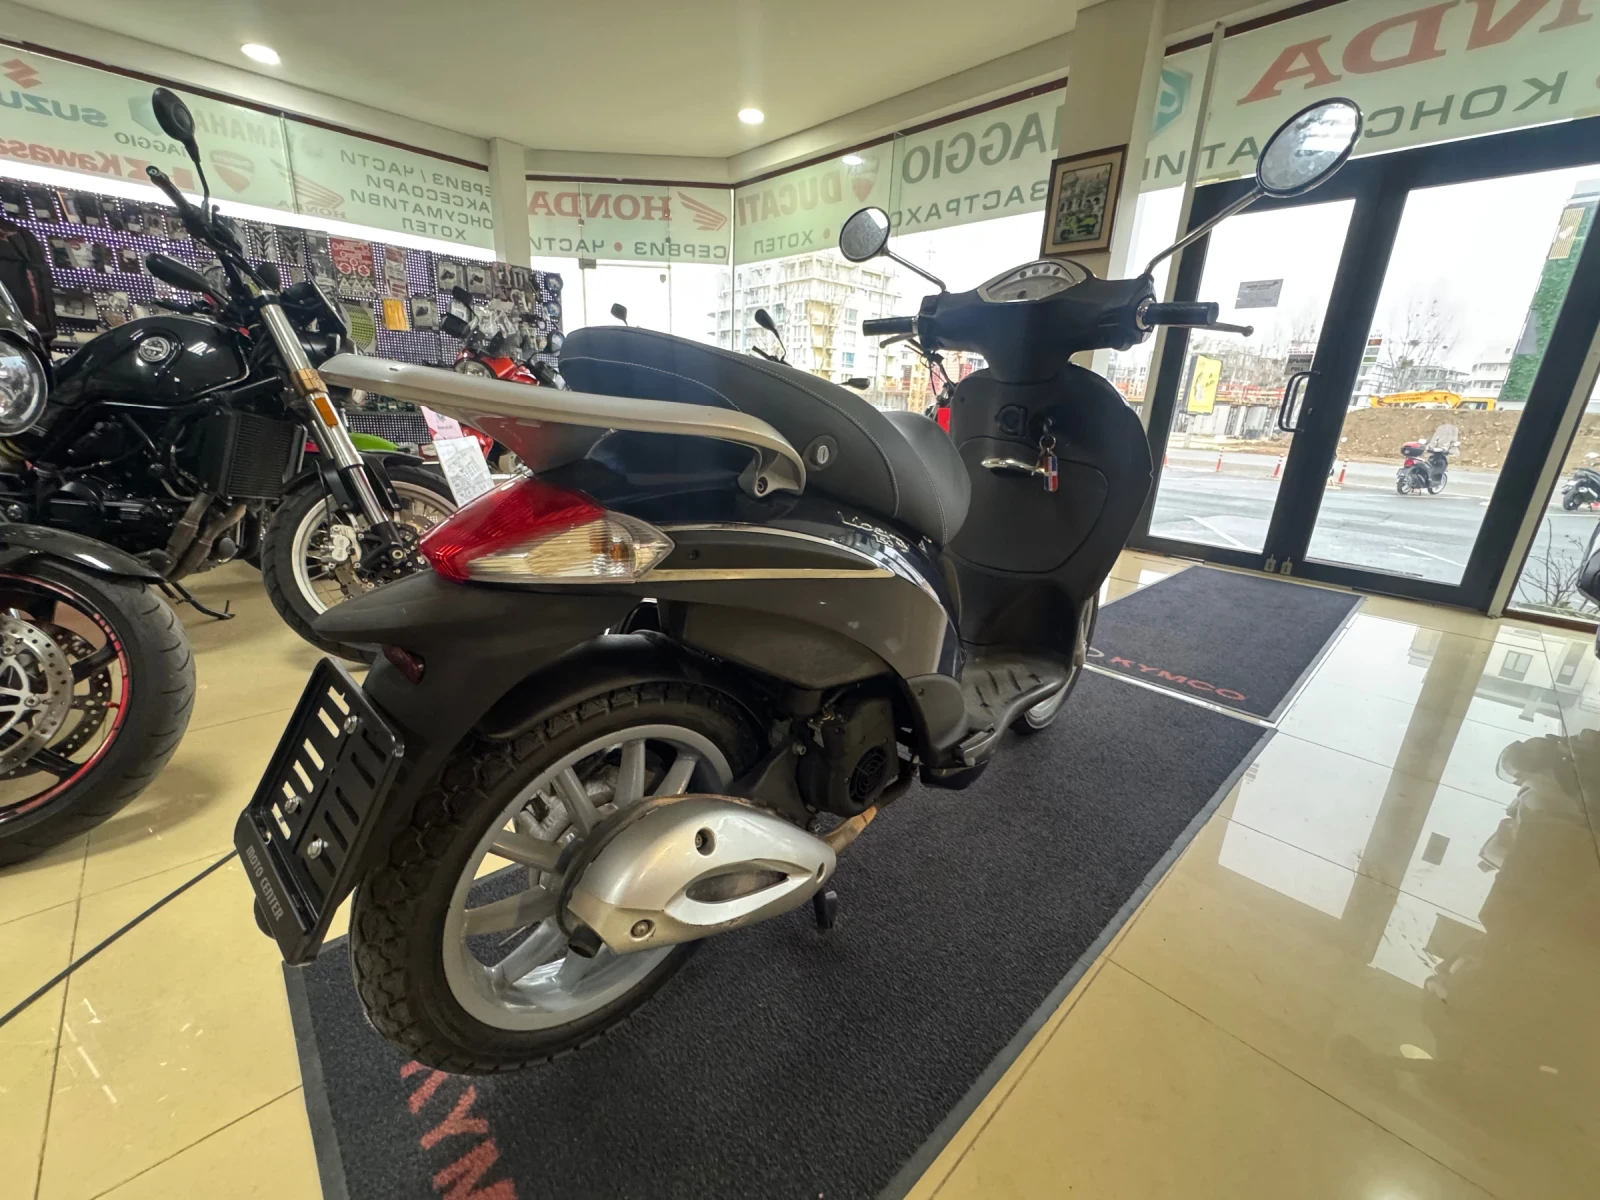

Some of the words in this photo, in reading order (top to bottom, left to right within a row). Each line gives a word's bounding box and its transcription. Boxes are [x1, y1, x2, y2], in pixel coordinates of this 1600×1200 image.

[1110, 655, 1246, 701] KYMCO
[245, 844, 264, 878] MOTO
[259, 876, 285, 921] CENTER
